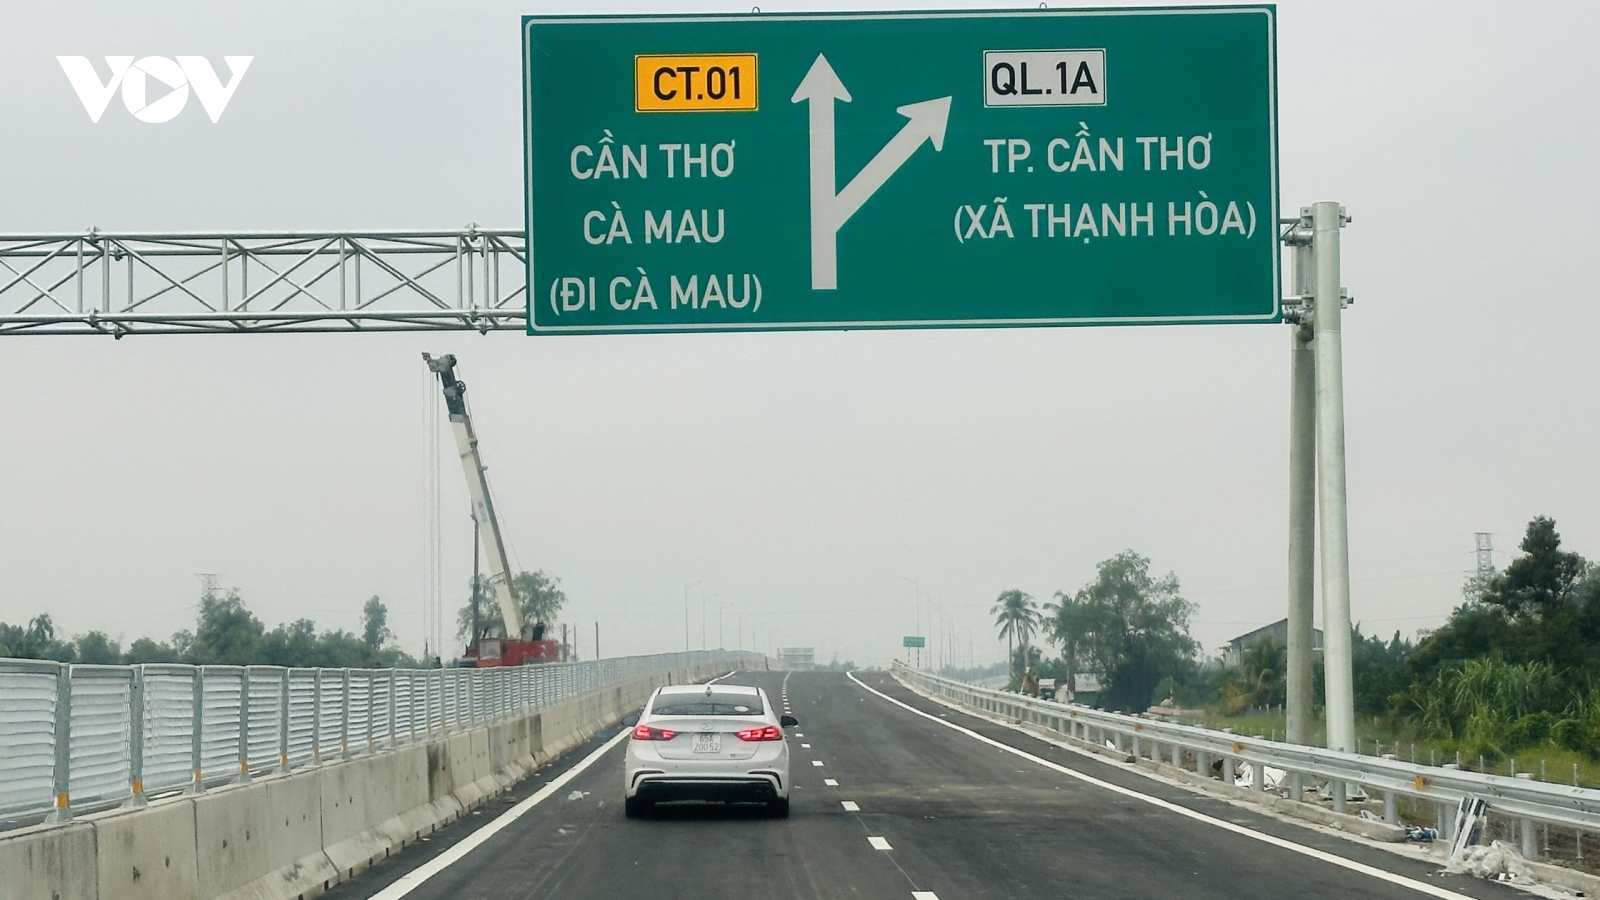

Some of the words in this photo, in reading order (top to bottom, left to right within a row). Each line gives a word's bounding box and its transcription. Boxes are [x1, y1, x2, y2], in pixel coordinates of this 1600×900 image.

[654, 67, 740, 100] CT.01
[991, 61, 1097, 96] QL.1A
[571, 129, 646, 179] CẦN
[660, 139, 735, 177] THƠ
[984, 139, 1033, 172] TP.
[1048, 121, 1123, 172] CẦN
[1136, 132, 1212, 170] THƠ
[584, 201, 632, 245] CÀ
[645, 209, 725, 243] MAU
[954, 196, 1014, 243] (XÃ
[1024, 202, 1153, 243] THẠNH
[1169, 190, 1256, 239] HÒA)
[550, 277, 595, 315] (ĐI
[610, 267, 656, 311] CÀ
[671, 274, 762, 312] MAU)
